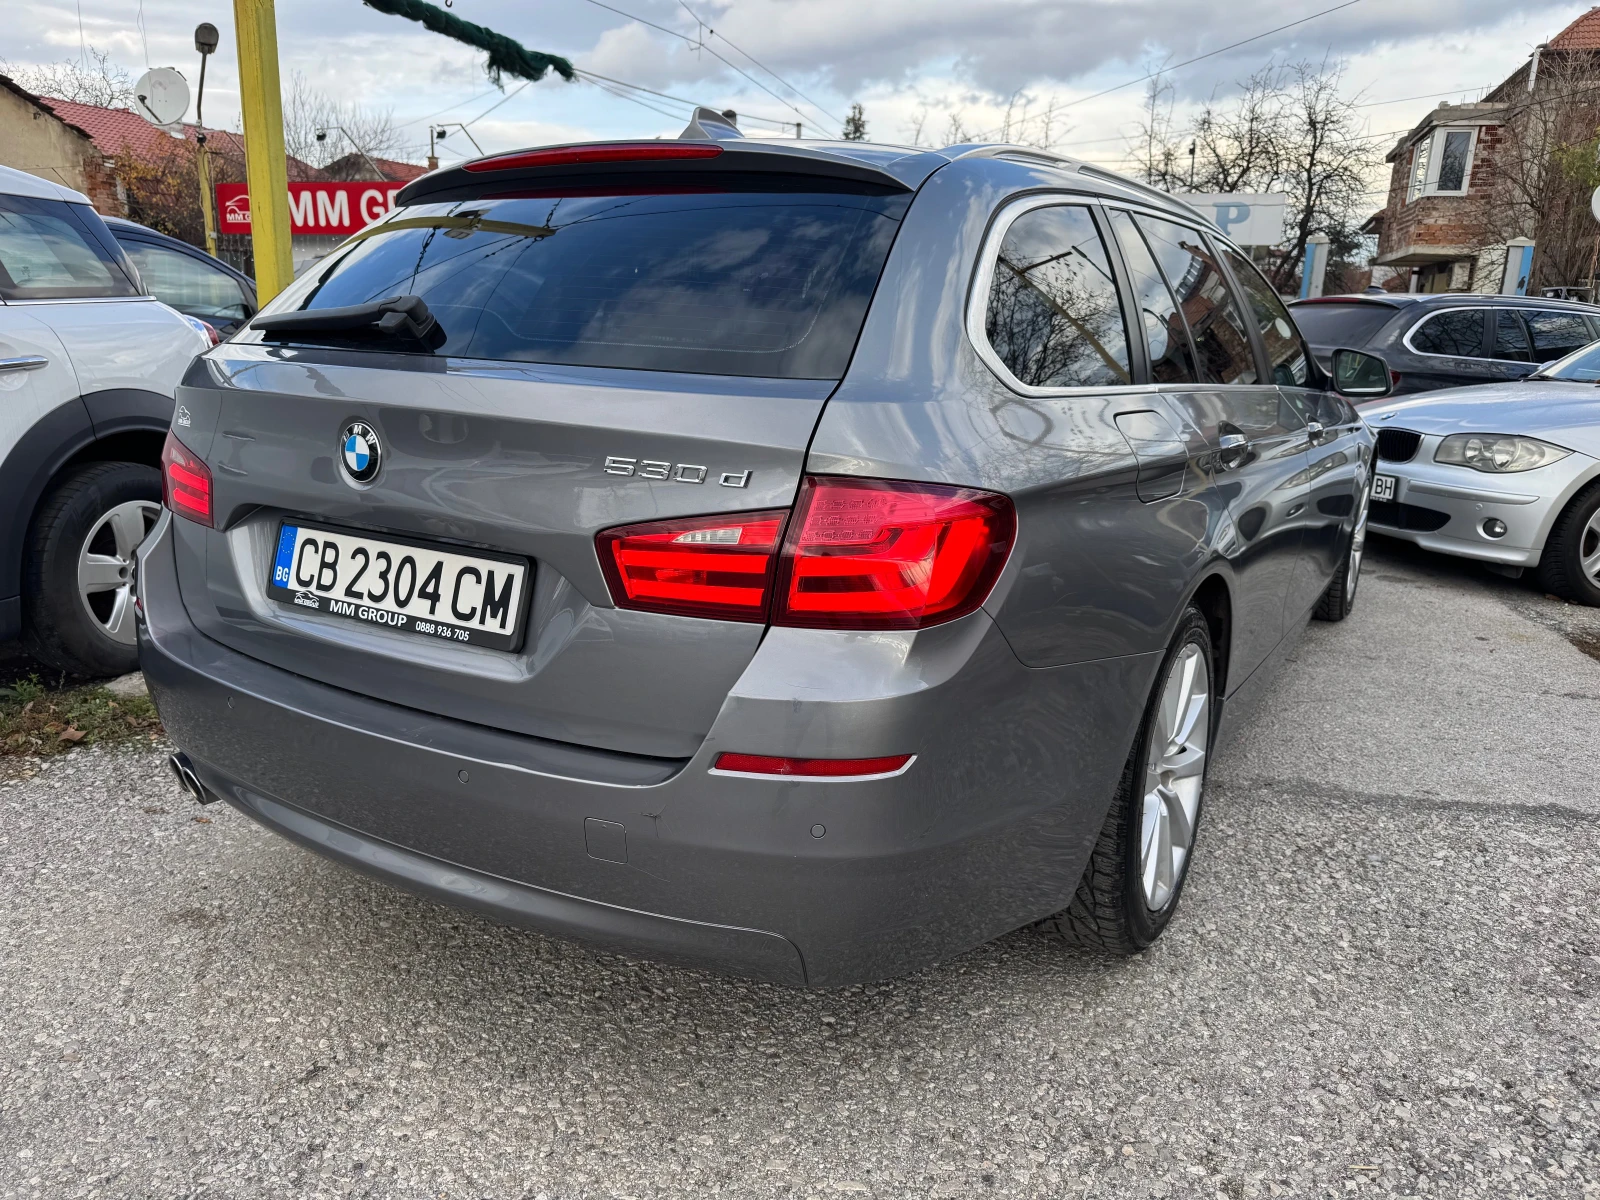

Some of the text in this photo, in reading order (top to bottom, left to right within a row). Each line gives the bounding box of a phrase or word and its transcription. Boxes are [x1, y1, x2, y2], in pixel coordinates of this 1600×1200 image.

[227, 212, 243, 221] MM
[288, 190, 350, 227] MM
[1212, 202, 1250, 236] P
[343, 425, 376, 445] BMW
[604, 456, 753, 488] 530 d
[1374, 478, 1393, 497] BH
[275, 566, 289, 582] BG
[296, 538, 515, 629] CB 2304 CM
[329, 600, 355, 616] MM
[358, 606, 407, 627] GROUP
[415, 621, 435, 634] 0888
[437, 625, 452, 637] 936
[453, 629, 469, 641] 705
